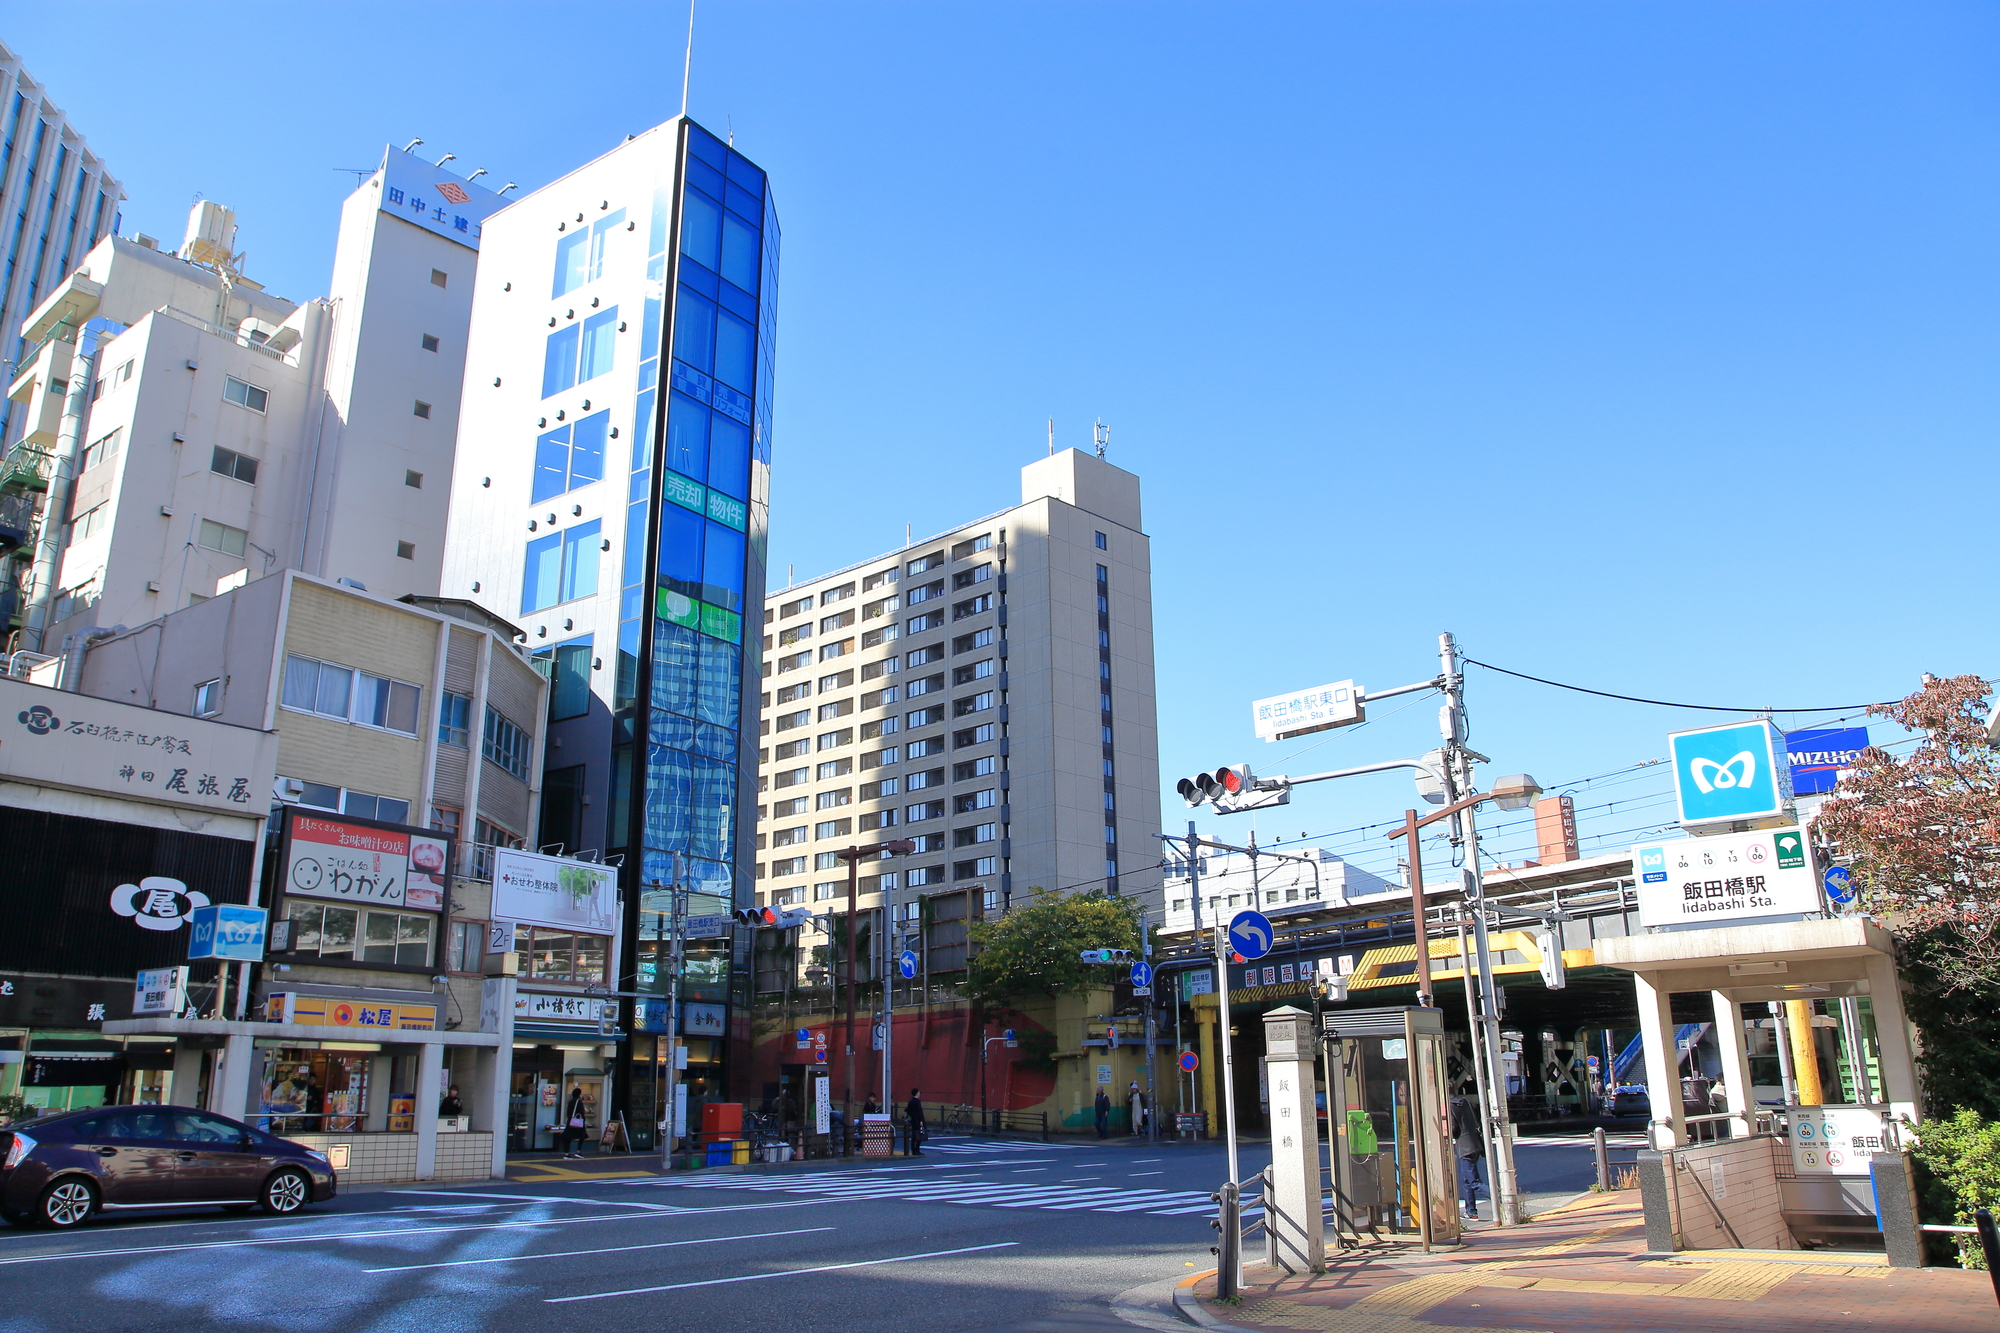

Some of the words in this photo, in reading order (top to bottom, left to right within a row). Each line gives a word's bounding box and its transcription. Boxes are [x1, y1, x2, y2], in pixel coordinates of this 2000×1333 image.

[714, 396, 749, 424] リフォーム
[667, 475, 702, 508] 売却
[709, 497, 743, 526] 物件
[1258, 687, 1349, 721] 飯田橋駅東口
[1310, 709, 1327, 721] Sta.
[1329, 707, 1338, 716] E.
[1787, 749, 1861, 766] MIZUHO
[119, 764, 156, 782] 神田
[165, 767, 252, 804] 尾張屋
[299, 818, 344, 834] 具だくさんの
[338, 832, 404, 854] お味噌汁の店
[327, 856, 369, 871] ごはん処
[1728, 855, 1738, 863] 13
[1752, 853, 1763, 861] 06
[328, 868, 401, 899] わがん
[510, 876, 559, 892] おせわ整体院
[1682, 875, 1767, 901] 飯田橋駅
[142, 890, 179, 917] 尾
[1682, 896, 1745, 914] Iidabashi
[1749, 896, 1777, 908] Sta.
[492, 927, 511, 948] 2F
[358, 1007, 392, 1026] 松屋
[1278, 1079, 1293, 1149] 飯田橋
[1851, 1135, 1885, 1149] 飯田
[1853, 1149, 1873, 1157] Iida
